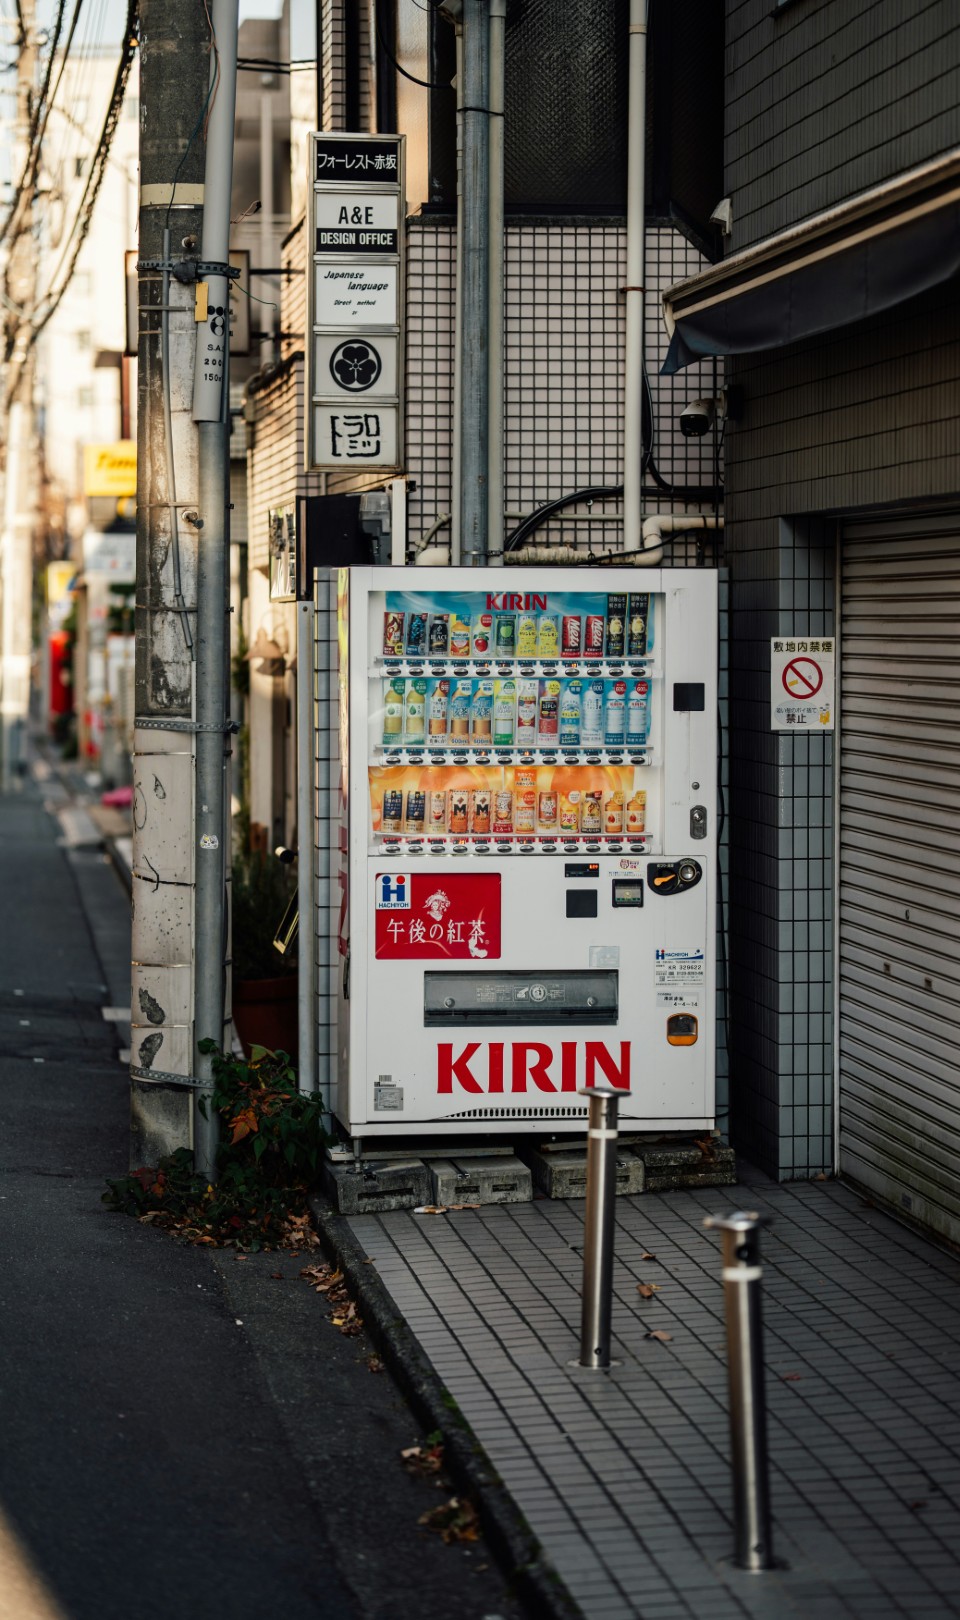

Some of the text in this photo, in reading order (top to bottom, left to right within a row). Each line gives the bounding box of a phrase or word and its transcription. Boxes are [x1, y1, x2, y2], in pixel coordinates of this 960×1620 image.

[317, 153, 397, 170] フォーレスト赤坂
[338, 206, 374, 225] A&E
[320, 232, 393, 245] DESIGN OFFICE
[324, 271, 364, 280] Japanese
[347, 282, 389, 291] language
[486, 593, 547, 611] KIRIN
[568, 618, 580, 648] Mets
[591, 618, 603, 648] Mets
[773, 641, 833, 653] 敷地内禁煙
[786, 713, 807, 724] 禁止
[387, 918, 486, 944] 午後の紅茶
[437, 1041, 631, 1094] KIRIN
